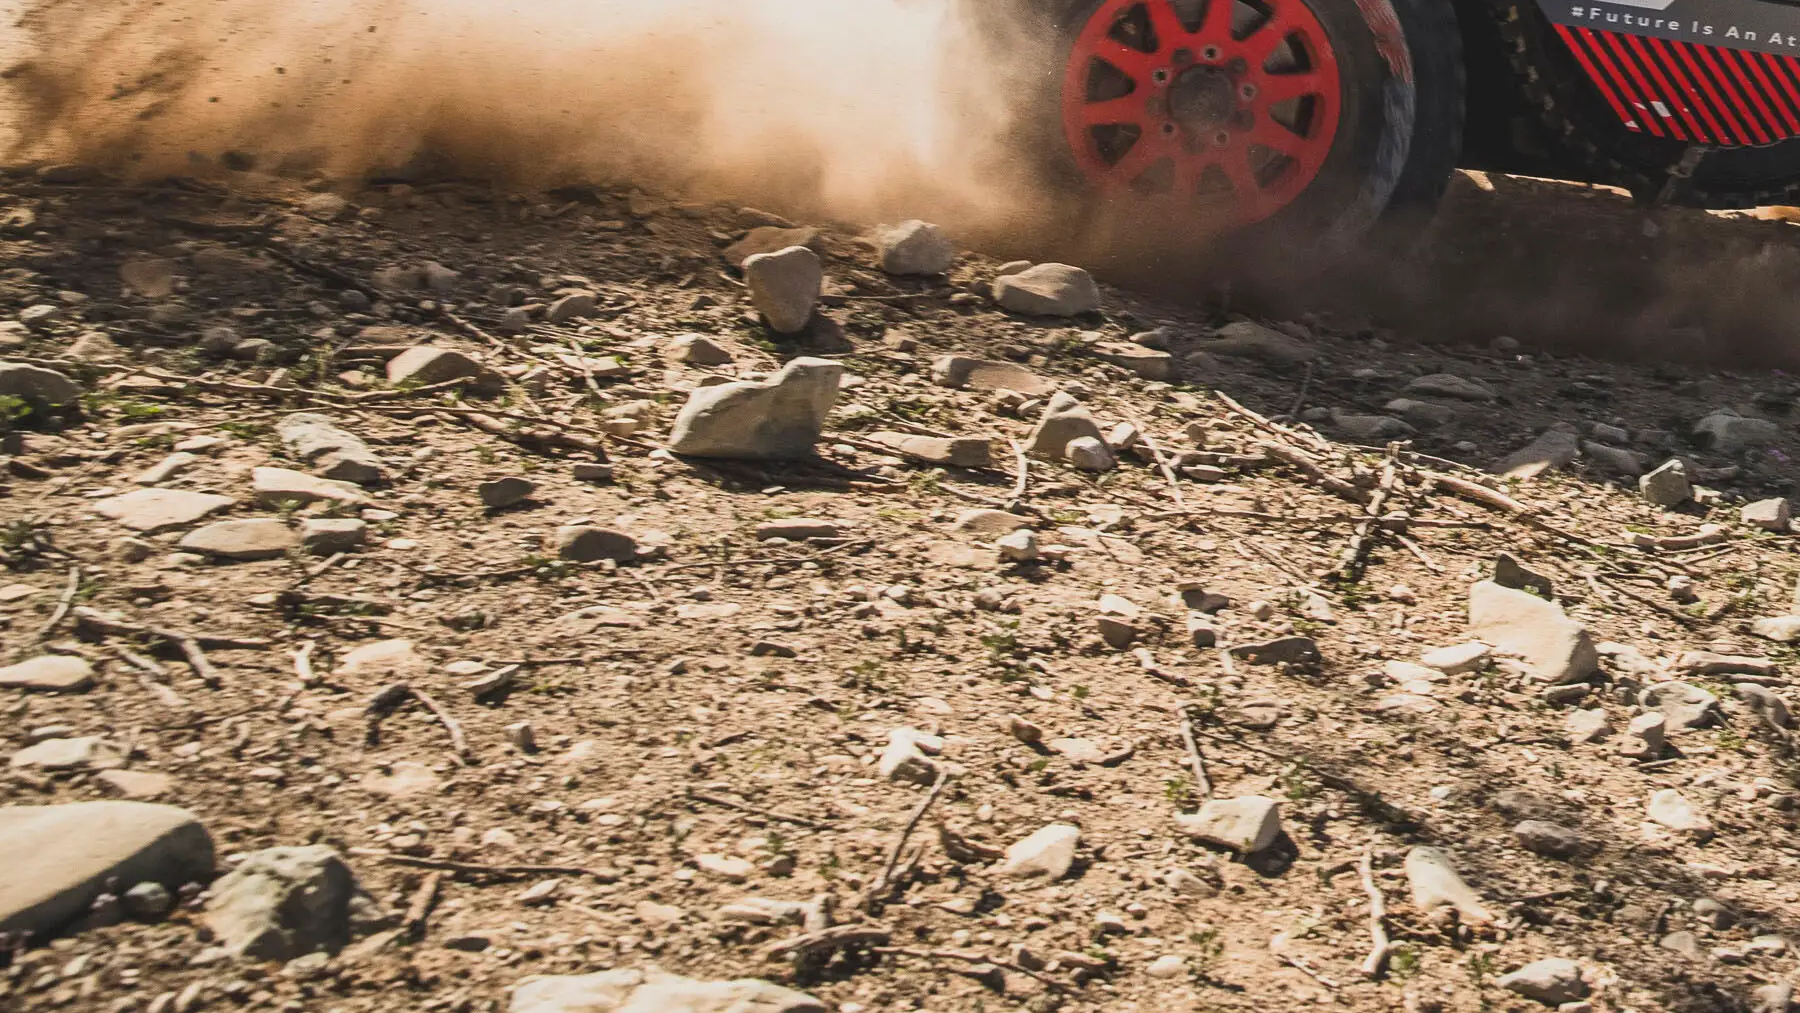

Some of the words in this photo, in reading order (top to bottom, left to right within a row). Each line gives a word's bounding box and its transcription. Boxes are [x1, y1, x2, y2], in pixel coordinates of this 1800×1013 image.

[1570, 4, 1680, 31] #Future
[1691, 20, 1713, 35] Is
[1725, 25, 1757, 41] An
